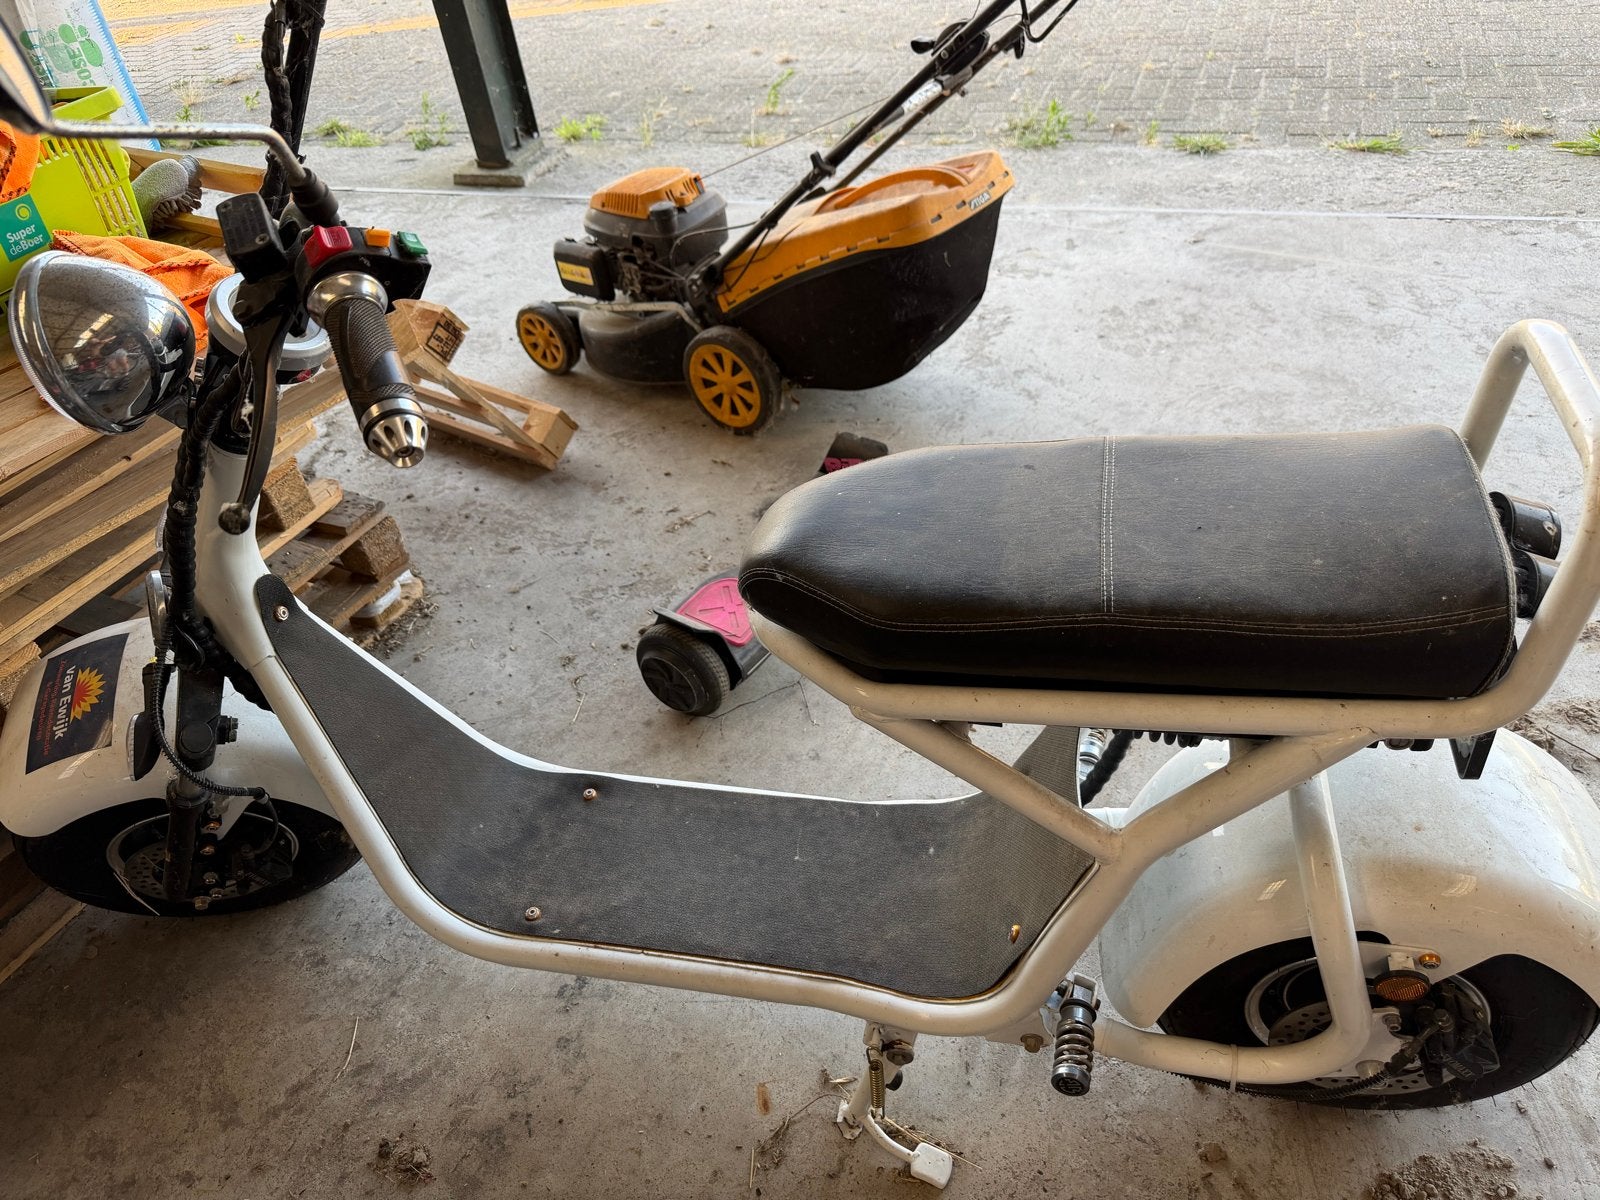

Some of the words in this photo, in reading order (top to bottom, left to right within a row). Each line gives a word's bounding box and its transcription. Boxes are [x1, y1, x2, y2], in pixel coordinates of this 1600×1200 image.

[6, 224, 36, 243] Super
[10, 234, 43, 256] deBoer
[61, 665, 76, 693] van
[52, 696, 71, 740] Ewijk
